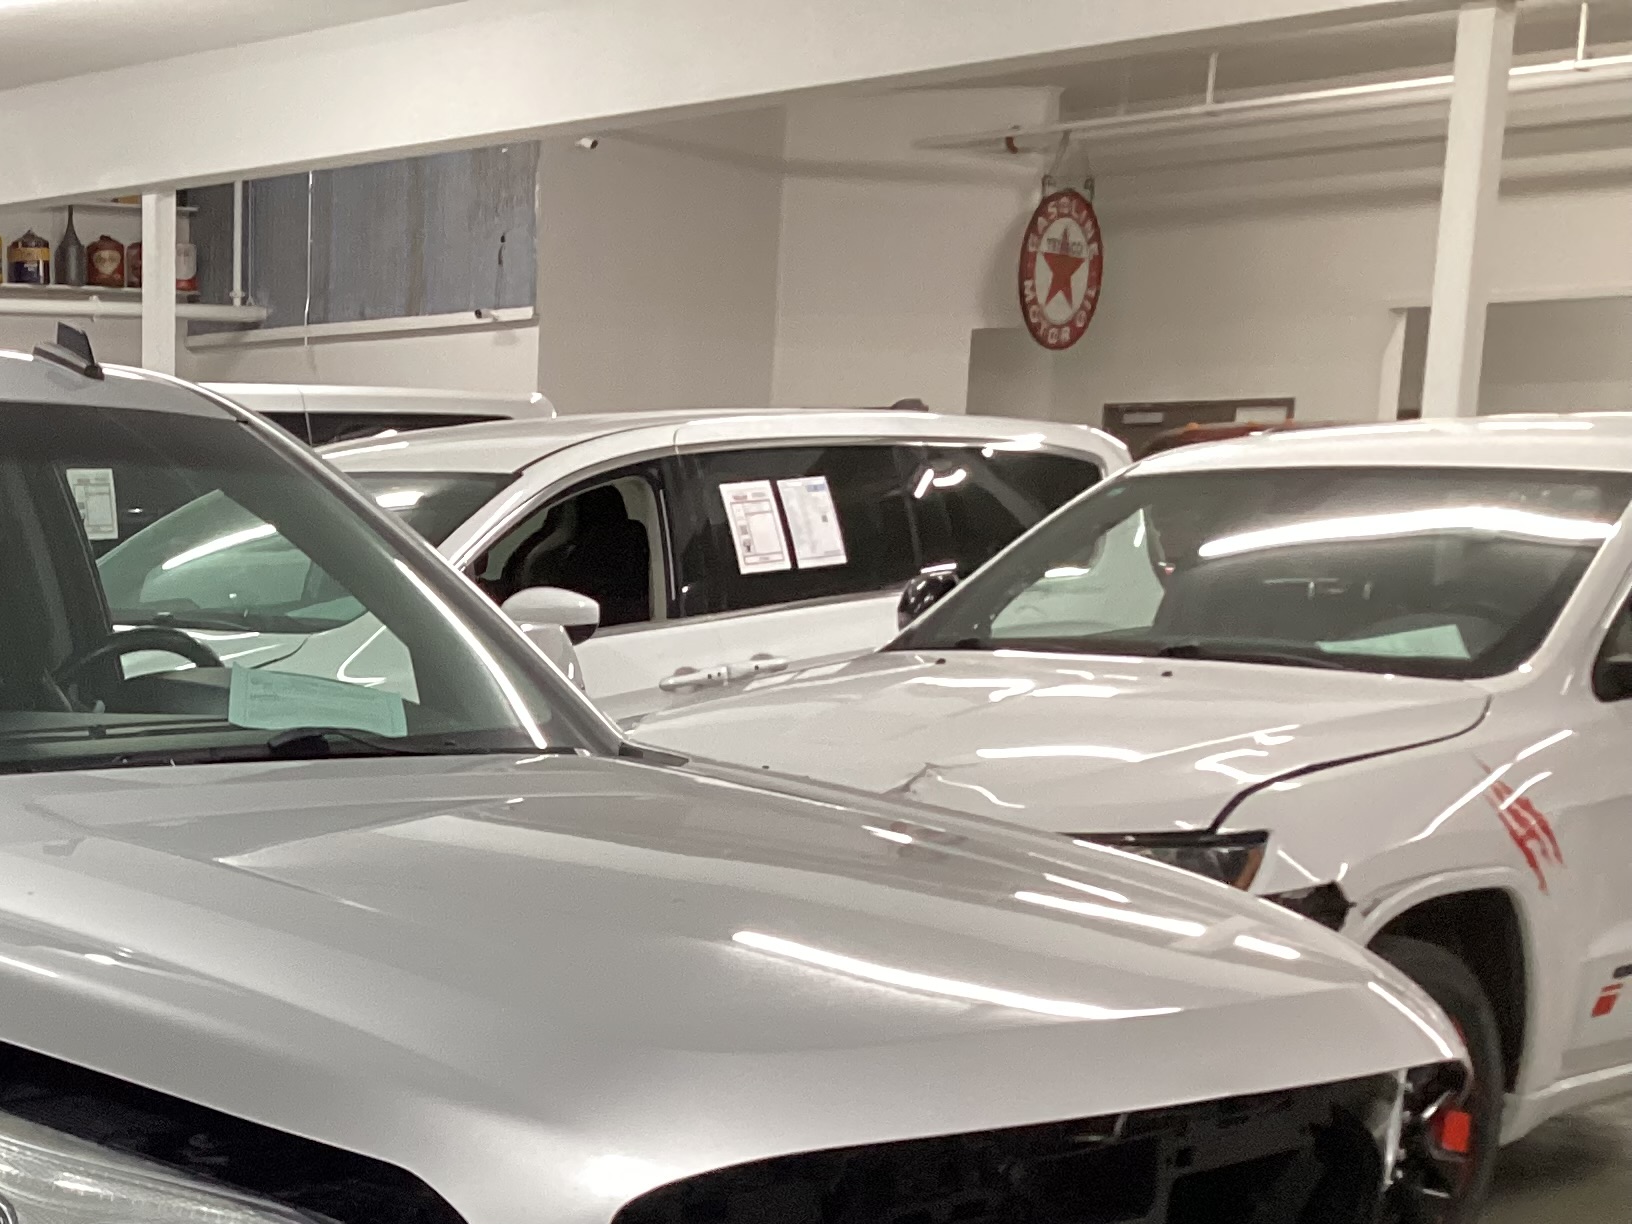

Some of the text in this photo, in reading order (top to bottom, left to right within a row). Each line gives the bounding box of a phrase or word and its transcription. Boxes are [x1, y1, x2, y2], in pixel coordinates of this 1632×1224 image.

[1028, 196, 1099, 259] GASOLINE
[1024, 280, 1097, 344] MOTOR OIL
